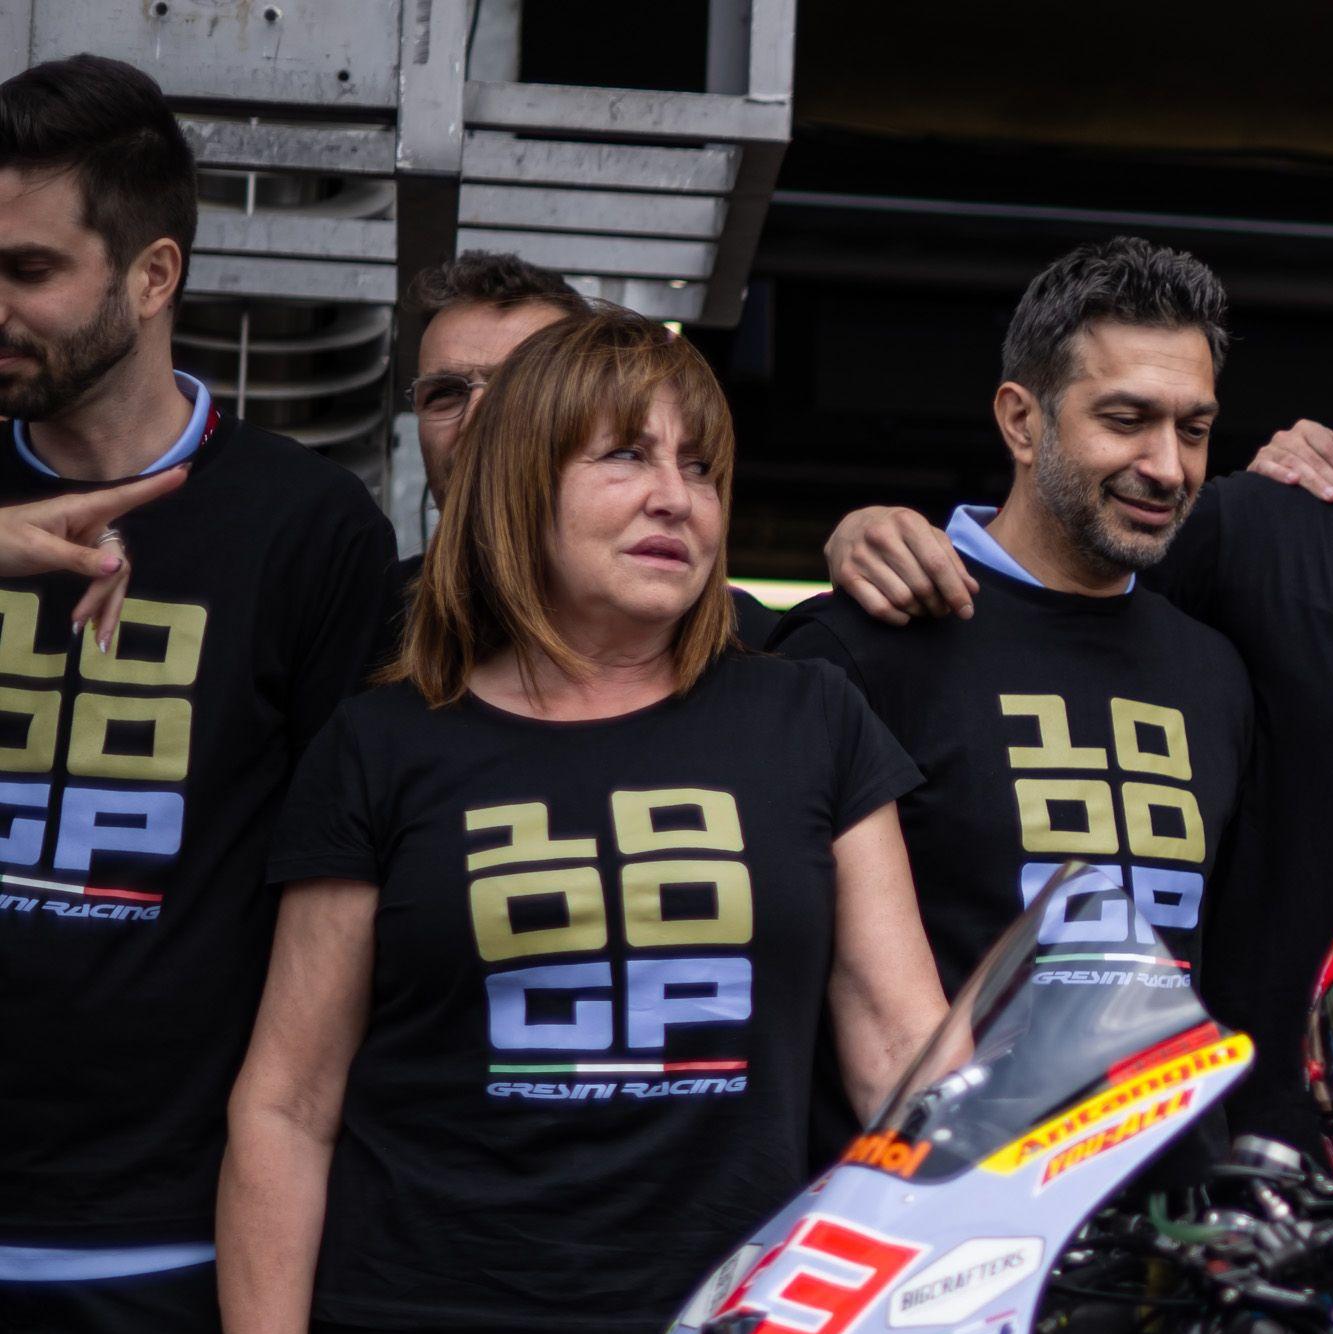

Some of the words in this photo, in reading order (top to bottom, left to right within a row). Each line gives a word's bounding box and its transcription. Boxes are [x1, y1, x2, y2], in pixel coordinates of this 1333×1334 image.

[1000, 694, 1192, 781] 10
[465, 787, 745, 872] 10
[1015, 778, 1206, 863] 00
[42, 900, 161, 921] RACING
[470, 860, 754, 962] 00
[1021, 862, 1204, 944] GP
[485, 957, 753, 1050] GP
[1032, 970, 1133, 986] GRESINI
[1136, 973, 1191, 988] RACING
[485, 1081, 618, 1099] GRESINI
[621, 1075, 747, 1098] RACING
[1013, 1046, 1240, 1163] Antangin
[900, 1250, 1025, 1311] BIGCRAFTERS
